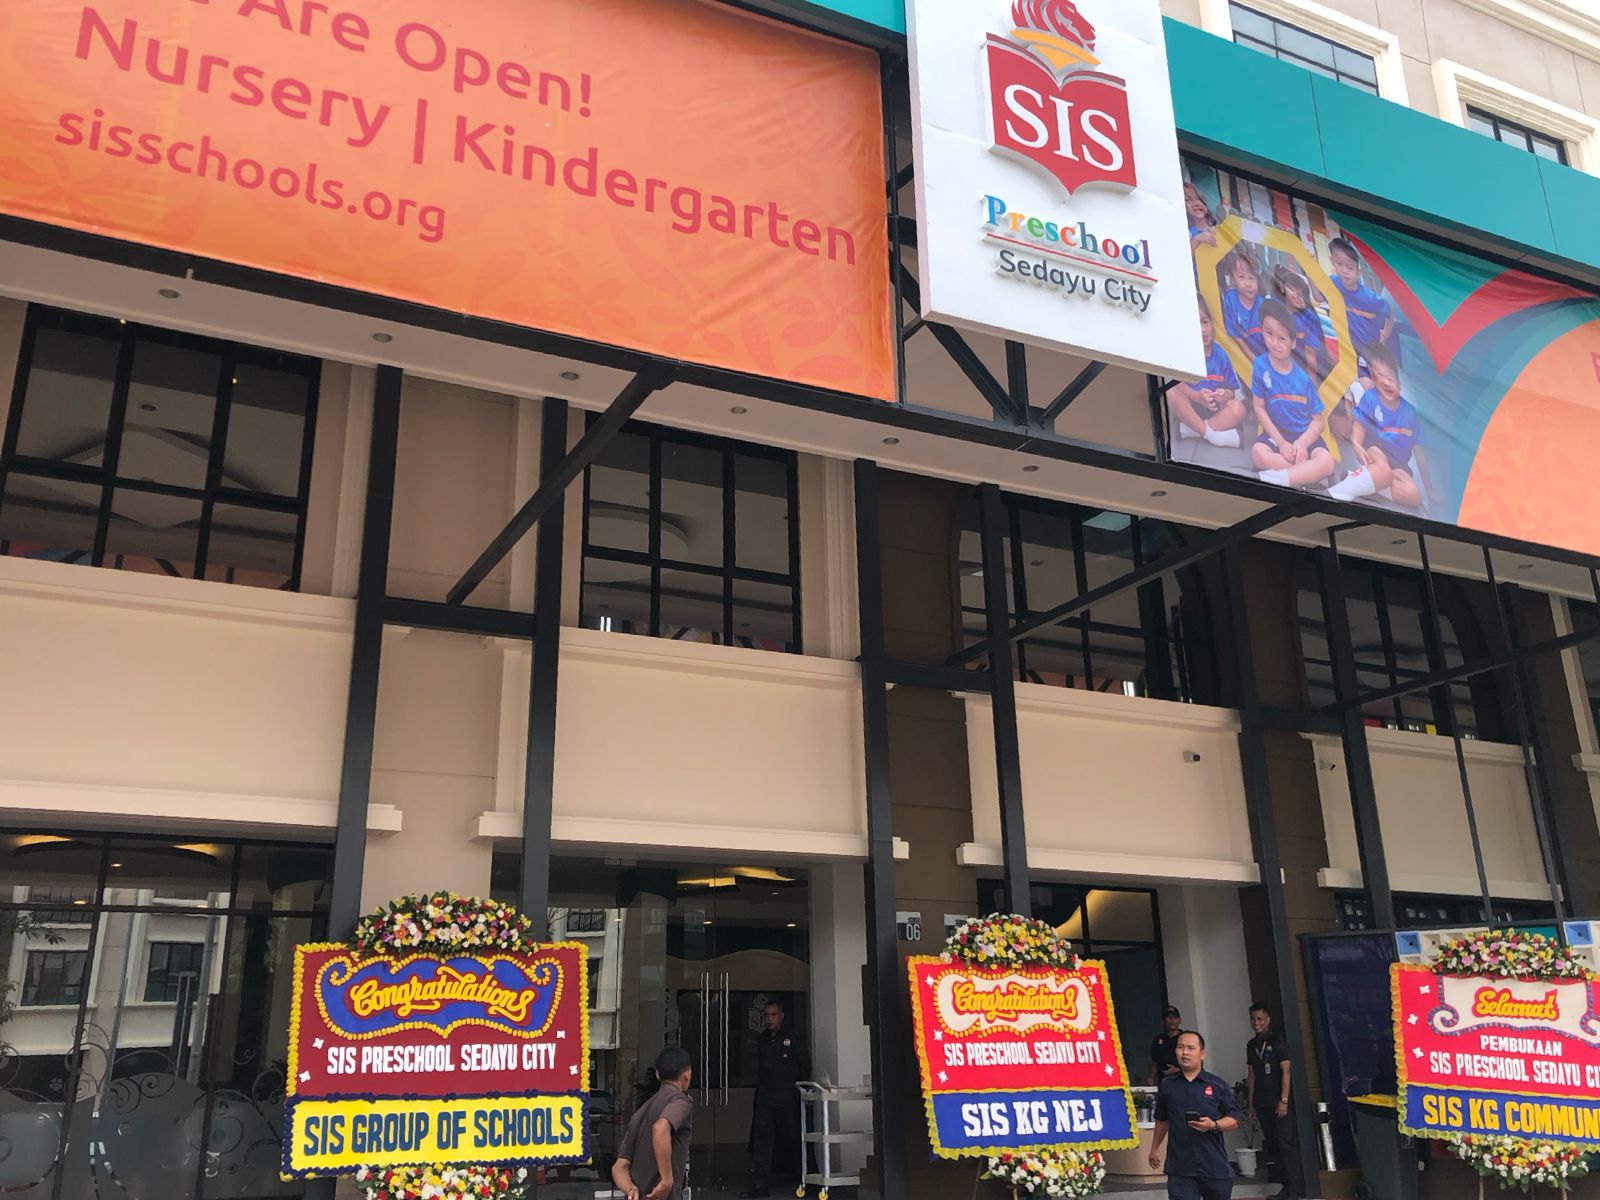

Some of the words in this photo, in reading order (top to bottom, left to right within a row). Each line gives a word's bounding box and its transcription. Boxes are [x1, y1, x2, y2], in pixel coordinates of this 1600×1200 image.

[395, 22, 592, 118] Open!
[74, 8, 391, 148] Nursery
[455, 115, 858, 266] Kindergarten
[1004, 84, 1124, 171] SIS
[55, 108, 447, 243] sisschools.org
[984, 194, 1152, 268] Preschool
[999, 250, 1096, 295] Sedayu
[1104, 278, 1151, 312] City
[906, 923, 921, 941] 06
[351, 966, 535, 1022] Congratulations
[953, 983, 1077, 1019] Congratulations
[1476, 989, 1557, 1020] Selamat
[327, 1047, 356, 1074] SIS
[361, 1044, 455, 1073] PRESCHOOL
[460, 1044, 517, 1071] SEDAYU
[522, 1043, 556, 1070] CITY
[944, 1043, 964, 1067] SIS
[967, 1042, 1033, 1066] PRESCHOOL
[1034, 1041, 1075, 1064] SEDAYU
[1078, 1041, 1101, 1063] CITY
[1480, 1034, 1562, 1057] PEMBUKAAN
[1429, 1051, 1452, 1074] SIS
[1456, 1056, 1529, 1082] PRESCHOOL
[1532, 1060, 1581, 1087] SEDAYU
[1585, 1064, 1600, 1089] CI
[304, 1115, 345, 1156] SIS
[351, 1112, 429, 1153] GROUP
[436, 1111, 466, 1149] OF
[473, 1106, 573, 1147] SCHOOLS
[961, 1103, 1010, 1137] SIS
[1013, 1101, 1049, 1135] KG
[1052, 1099, 1104, 1132] NEJ
[1423, 1094, 1463, 1127] SIS
[1470, 1098, 1499, 1131] KG
[1504, 1101, 1600, 1140] COMMUN
